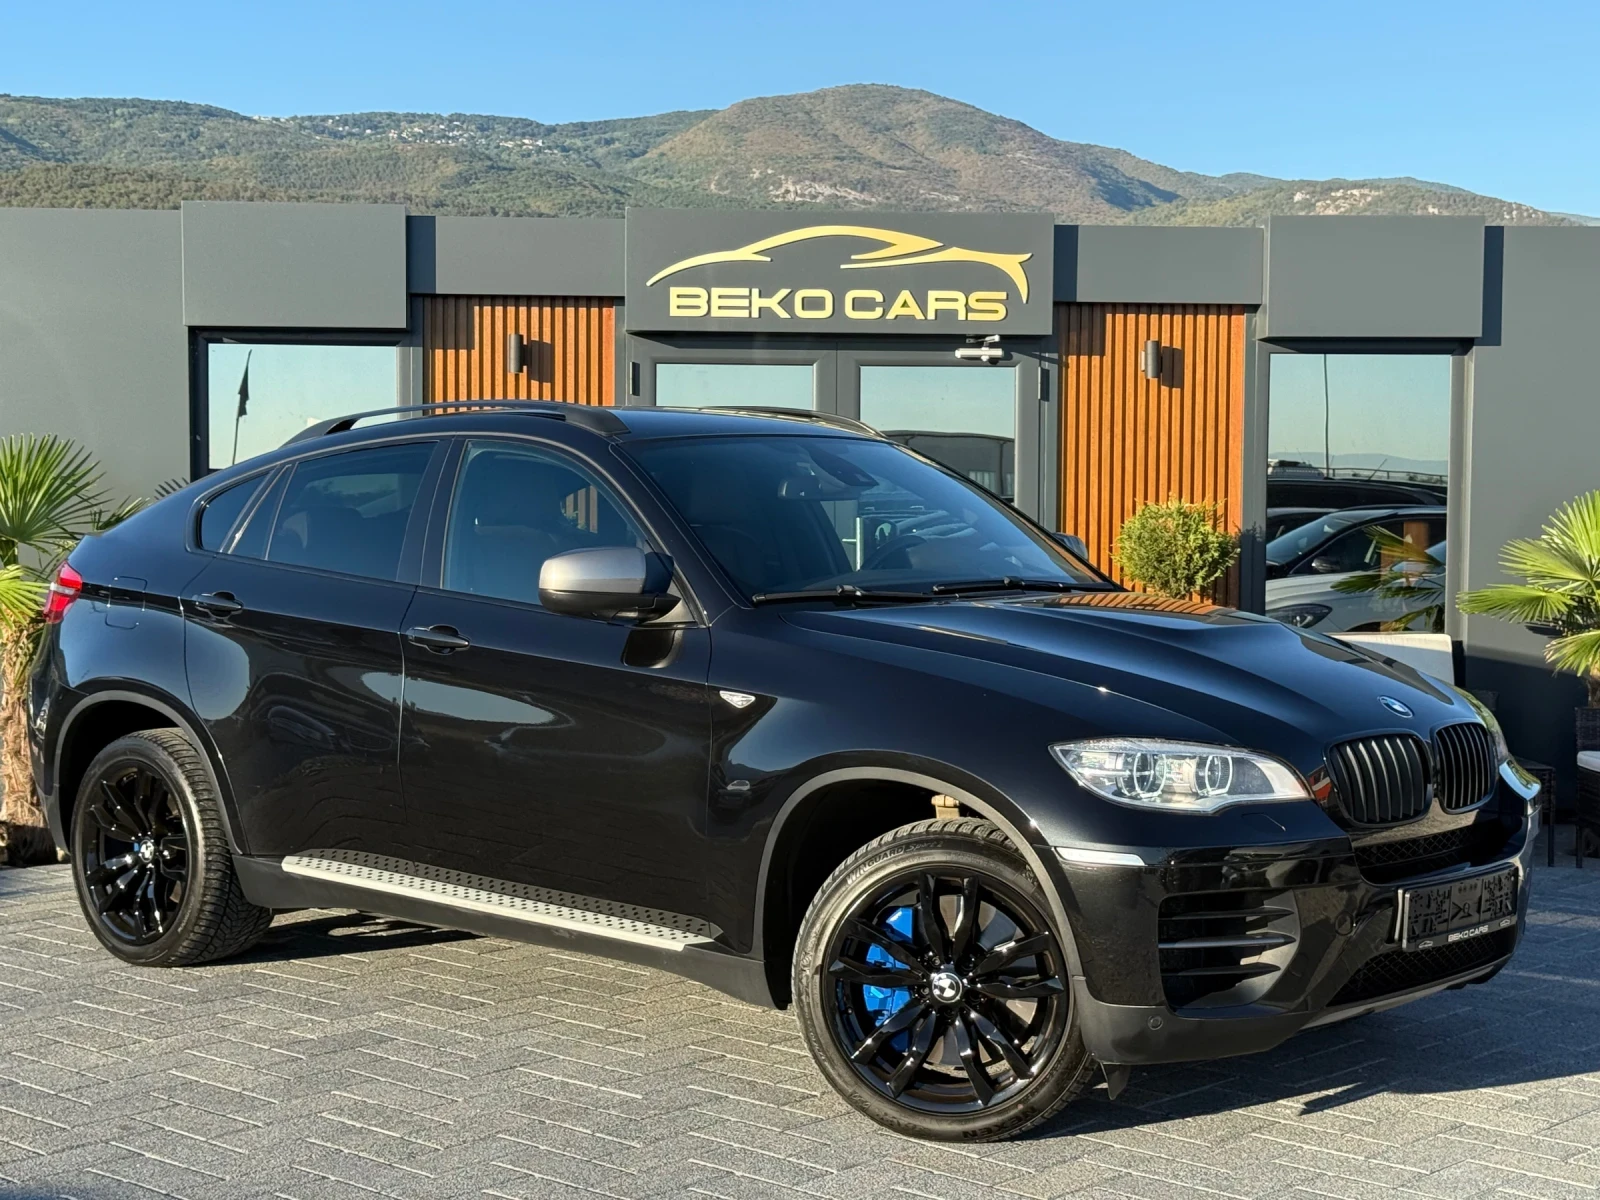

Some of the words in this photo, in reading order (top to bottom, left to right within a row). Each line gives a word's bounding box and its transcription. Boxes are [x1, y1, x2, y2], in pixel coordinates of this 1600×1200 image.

[669, 286, 834, 319] BEKO
[844, 289, 1008, 321] CARS
[846, 845, 905, 885] WINGUARD
[1448, 930, 1468, 942] BEKO
[1469, 925, 1488, 937] CARS
[962, 1106, 1037, 1138] NEXEN
